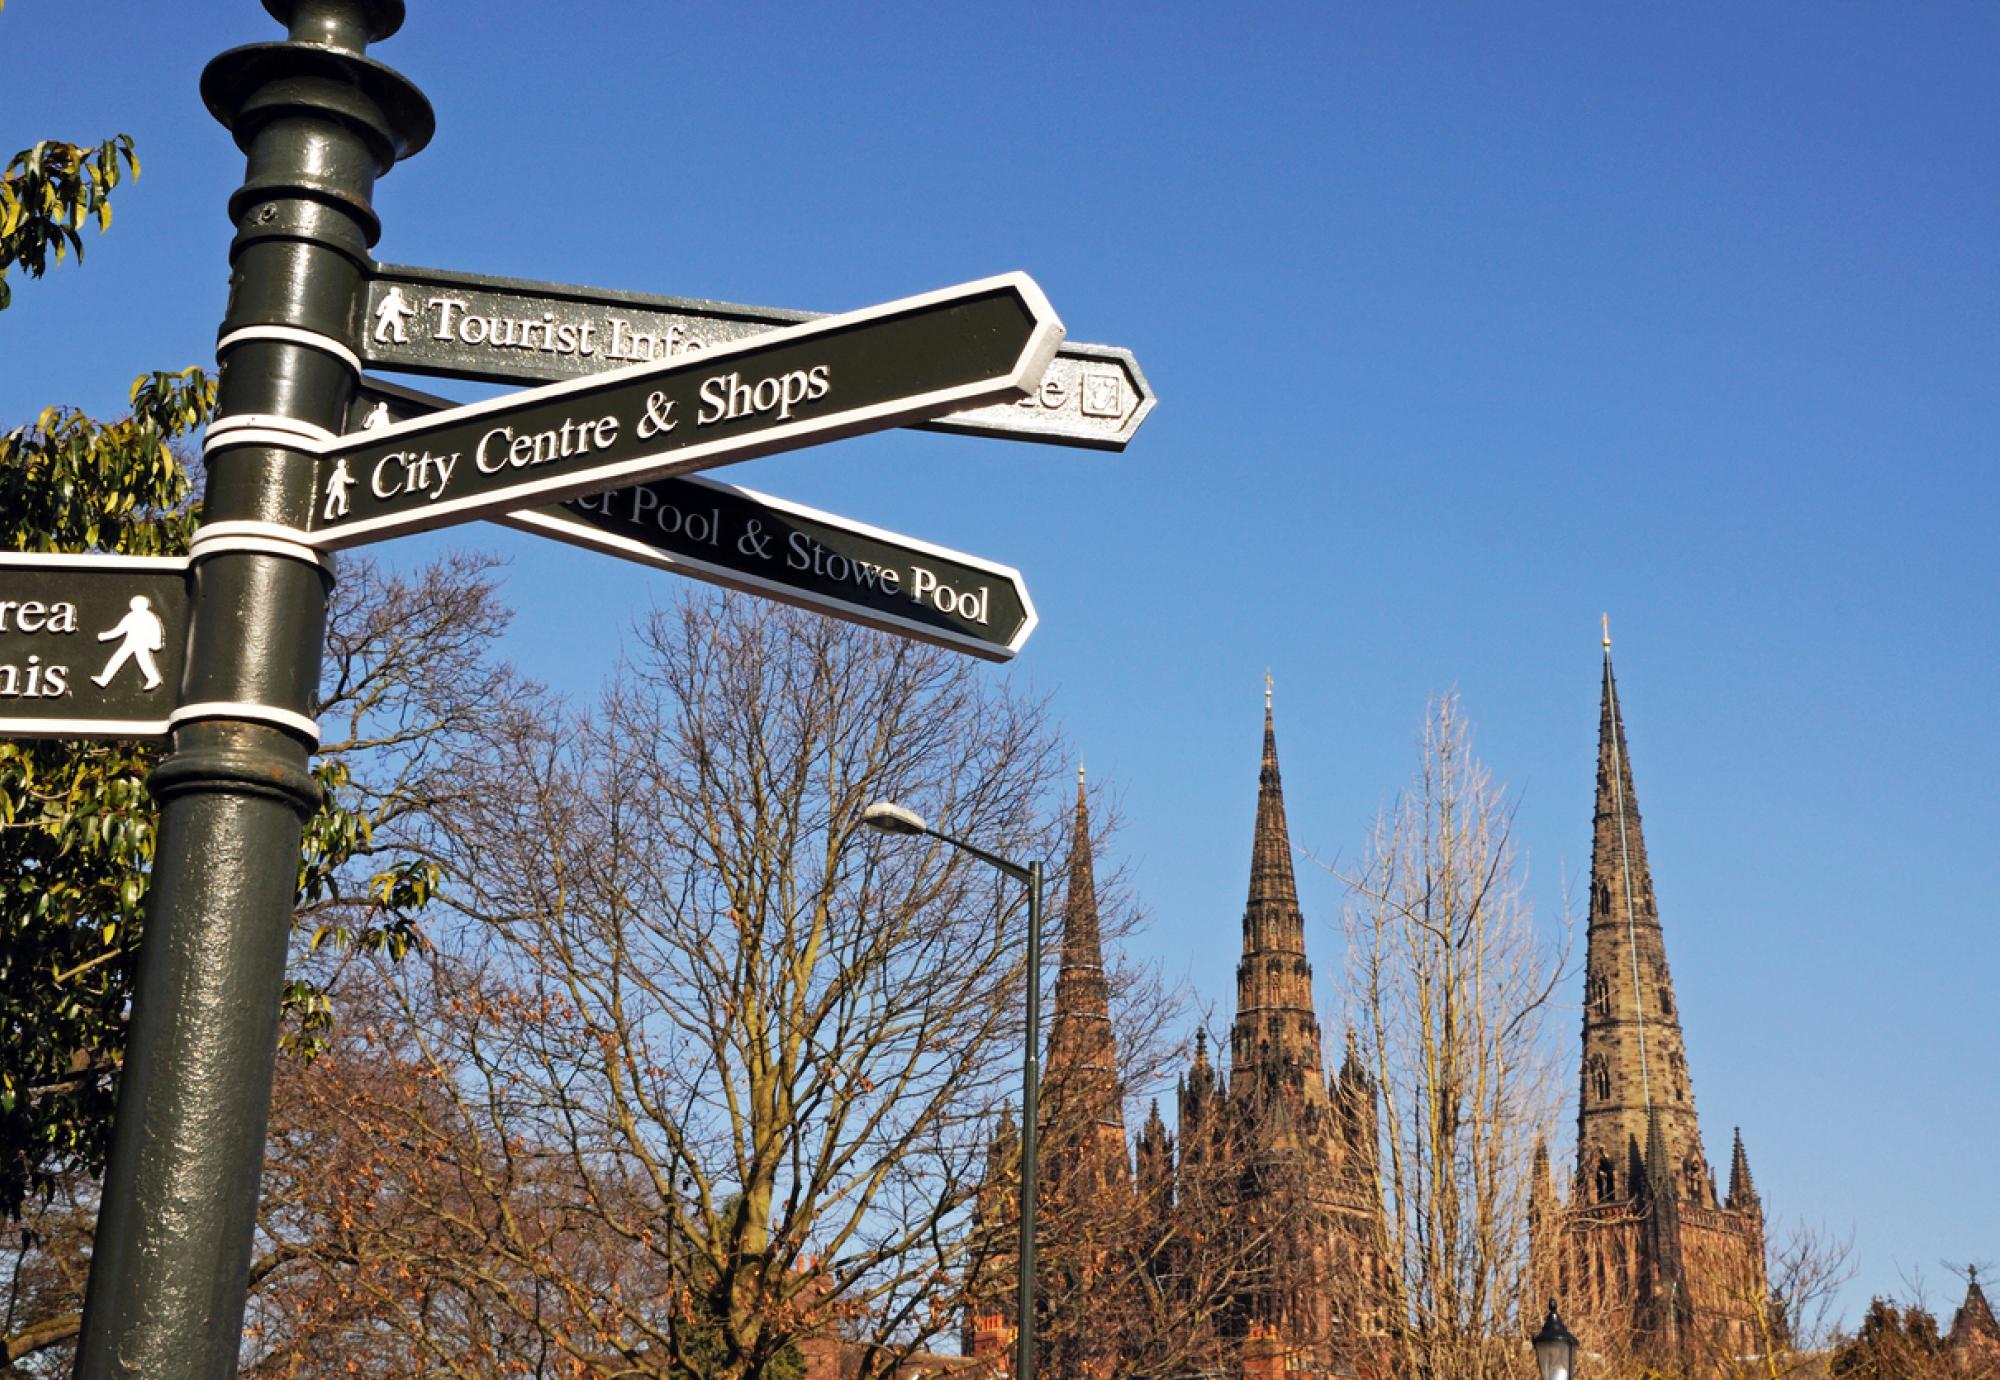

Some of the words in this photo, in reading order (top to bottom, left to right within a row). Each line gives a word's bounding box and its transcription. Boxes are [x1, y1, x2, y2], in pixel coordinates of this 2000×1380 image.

[427, 297, 596, 356] Tourist
[371, 449, 462, 500] City
[476, 417, 620, 474] Centre
[637, 391, 679, 440] &
[697, 364, 831, 421] Shops
[629, 485, 720, 547] Pool
[737, 518, 774, 560] &
[787, 531, 900, 596] Stowe
[910, 565, 989, 626] Pool
